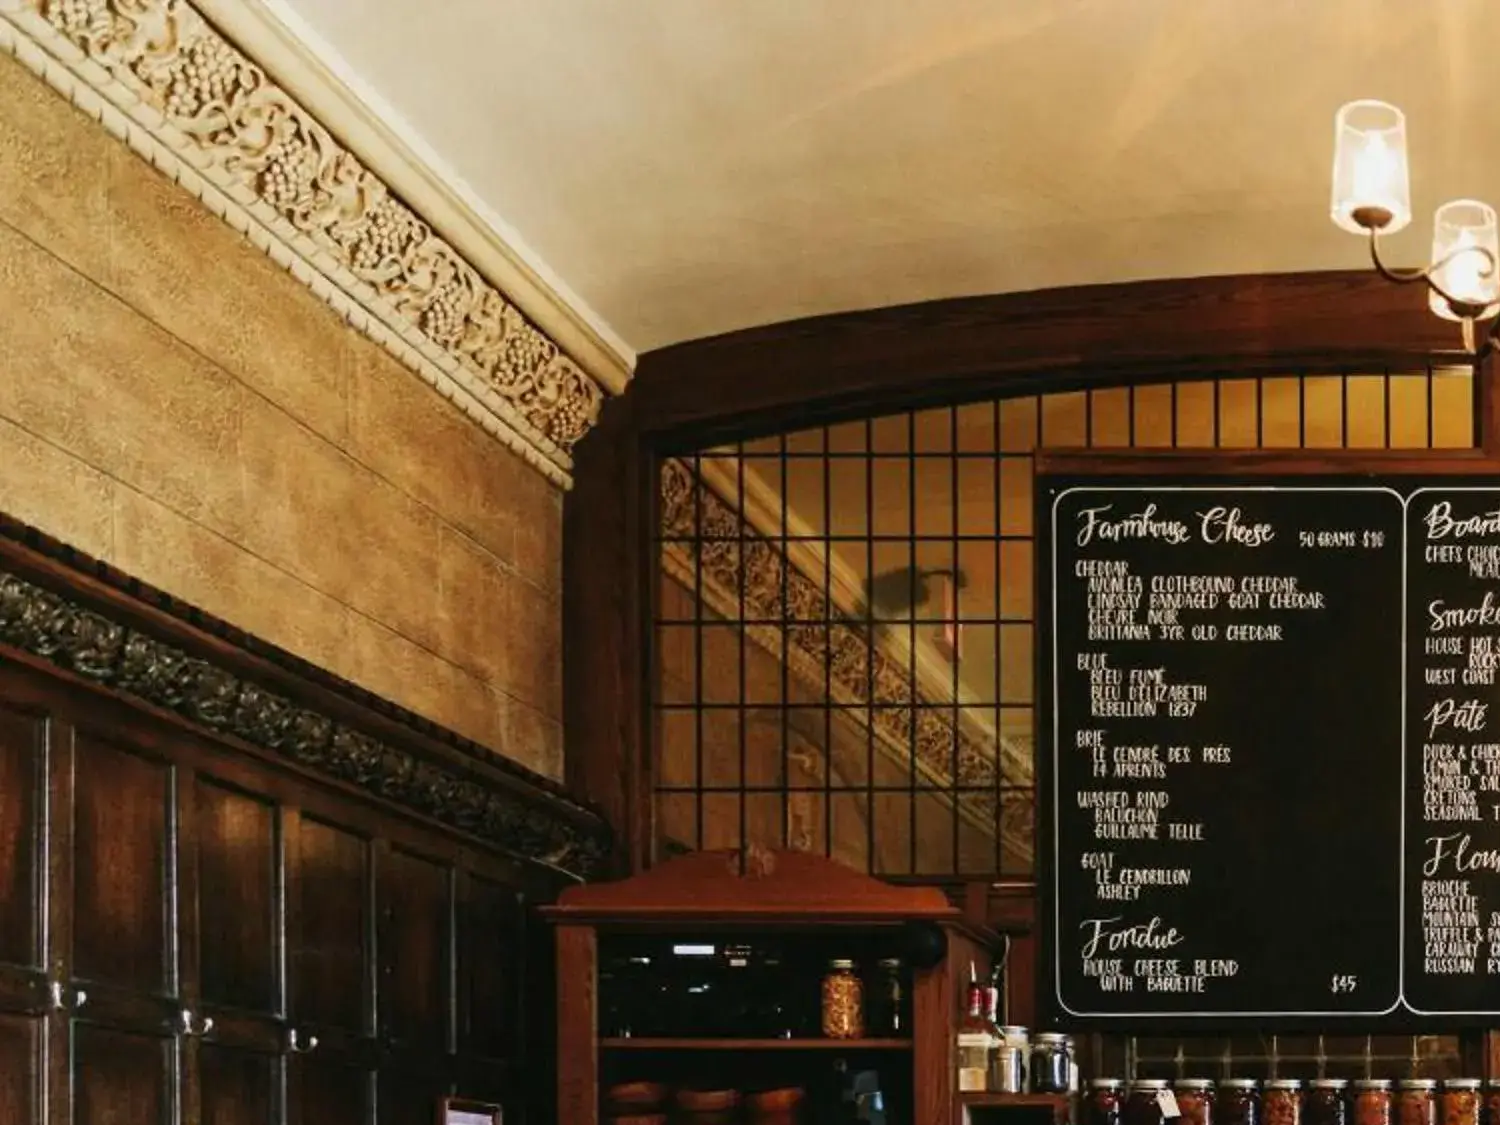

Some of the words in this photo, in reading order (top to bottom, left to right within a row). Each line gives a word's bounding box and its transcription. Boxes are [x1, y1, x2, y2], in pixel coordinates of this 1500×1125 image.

[1076, 503, 1191, 548] Farmhouse
[1196, 507, 1276, 547] Cheese
[1299, 531, 1315, 548] 50
[1074, 560, 1130, 577] CHEDDAR
[1151, 576, 1235, 593] CLOTHBOUND
[1241, 576, 1298, 593] CHEDDAR
[1229, 593, 1260, 609] GOAT
[1269, 593, 1326, 609] CHEDDAR
[1159, 624, 1185, 641] 3YR
[1191, 624, 1218, 641] OLD
[1226, 624, 1284, 641] CHEDDAR
[1425, 637, 1465, 655] HOUSE
[1077, 653, 1109, 671] BLUE
[1425, 668, 1456, 685] WEST
[1076, 730, 1108, 748] BRIE
[1168, 746, 1192, 763] DES
[1136, 791, 1169, 808] RIND
[1080, 852, 1115, 869] GOAT
[1096, 869, 1113, 886] LE
[1079, 915, 1185, 959] Fondue
[1083, 959, 1124, 977] HOUSE
[1133, 959, 1181, 977] CHEESE
[1194, 959, 1239, 977] BLEND
[1424, 958, 1475, 975] RUSSIAN
[1100, 976, 1134, 993] WITH
[1147, 976, 1206, 993] BAGUETTE
[1330, 974, 1358, 994] $45
